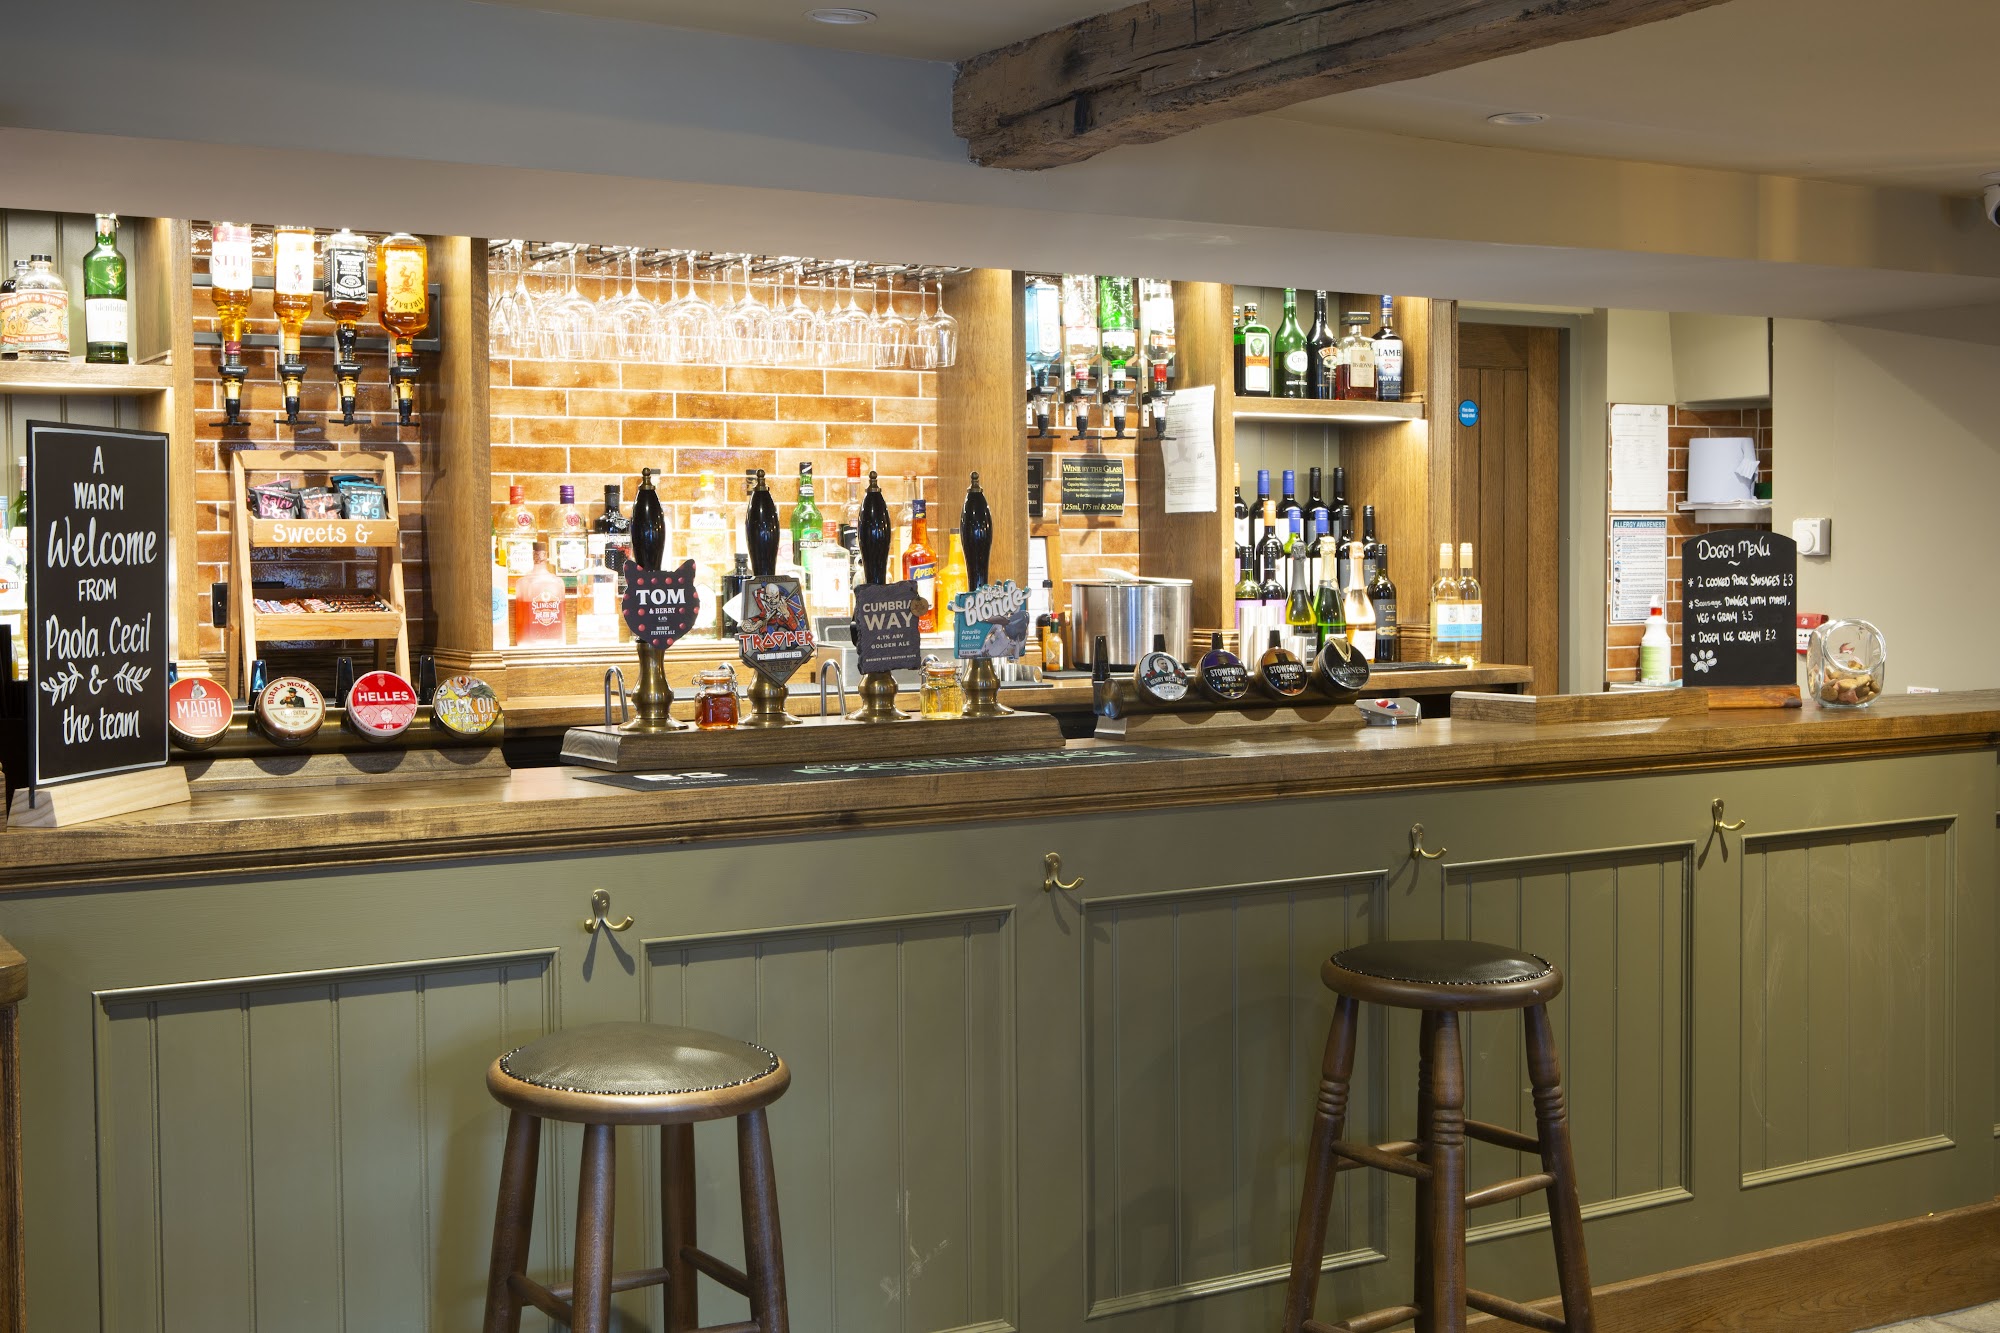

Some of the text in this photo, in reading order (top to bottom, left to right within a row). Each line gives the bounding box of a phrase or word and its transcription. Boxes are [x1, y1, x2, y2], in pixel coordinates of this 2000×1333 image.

[93, 445, 105, 475] A
[74, 481, 124, 511] WARM
[350, 494, 382, 506] Salty
[47, 515, 158, 569] Welcome
[272, 523, 374, 544] Sweets &
[1697, 536, 1771, 561] DOGGY MENU
[78, 577, 117, 602] FROM
[1697, 575, 1704, 588] 2
[635, 588, 686, 605] TOM
[1750, 596, 1767, 606] WITH
[863, 611, 913, 632] WAY
[1696, 612, 1710, 624] VEG
[1717, 611, 1738, 624] GRAVY
[109, 612, 151, 657] Cecil
[739, 630, 816, 655] TROOPER
[1698, 630, 1721, 644] DOGGY
[1723, 630, 1734, 642] ICE
[1738, 630, 1762, 643] CREAM
[1209, 667, 1245, 677] STOWFORD
[1269, 664, 1304, 674] STOWFORD
[1279, 672, 1297, 680] PRESS
[1331, 666, 1367, 675] GUINNESS
[88, 664, 108, 695] &
[267, 681, 319, 705] BIRRA MORETTI
[357, 691, 410, 702] HELLES
[438, 697, 498, 716] NECK OIL
[63, 704, 140, 745] the team
[482, 713, 494, 722] IPA
